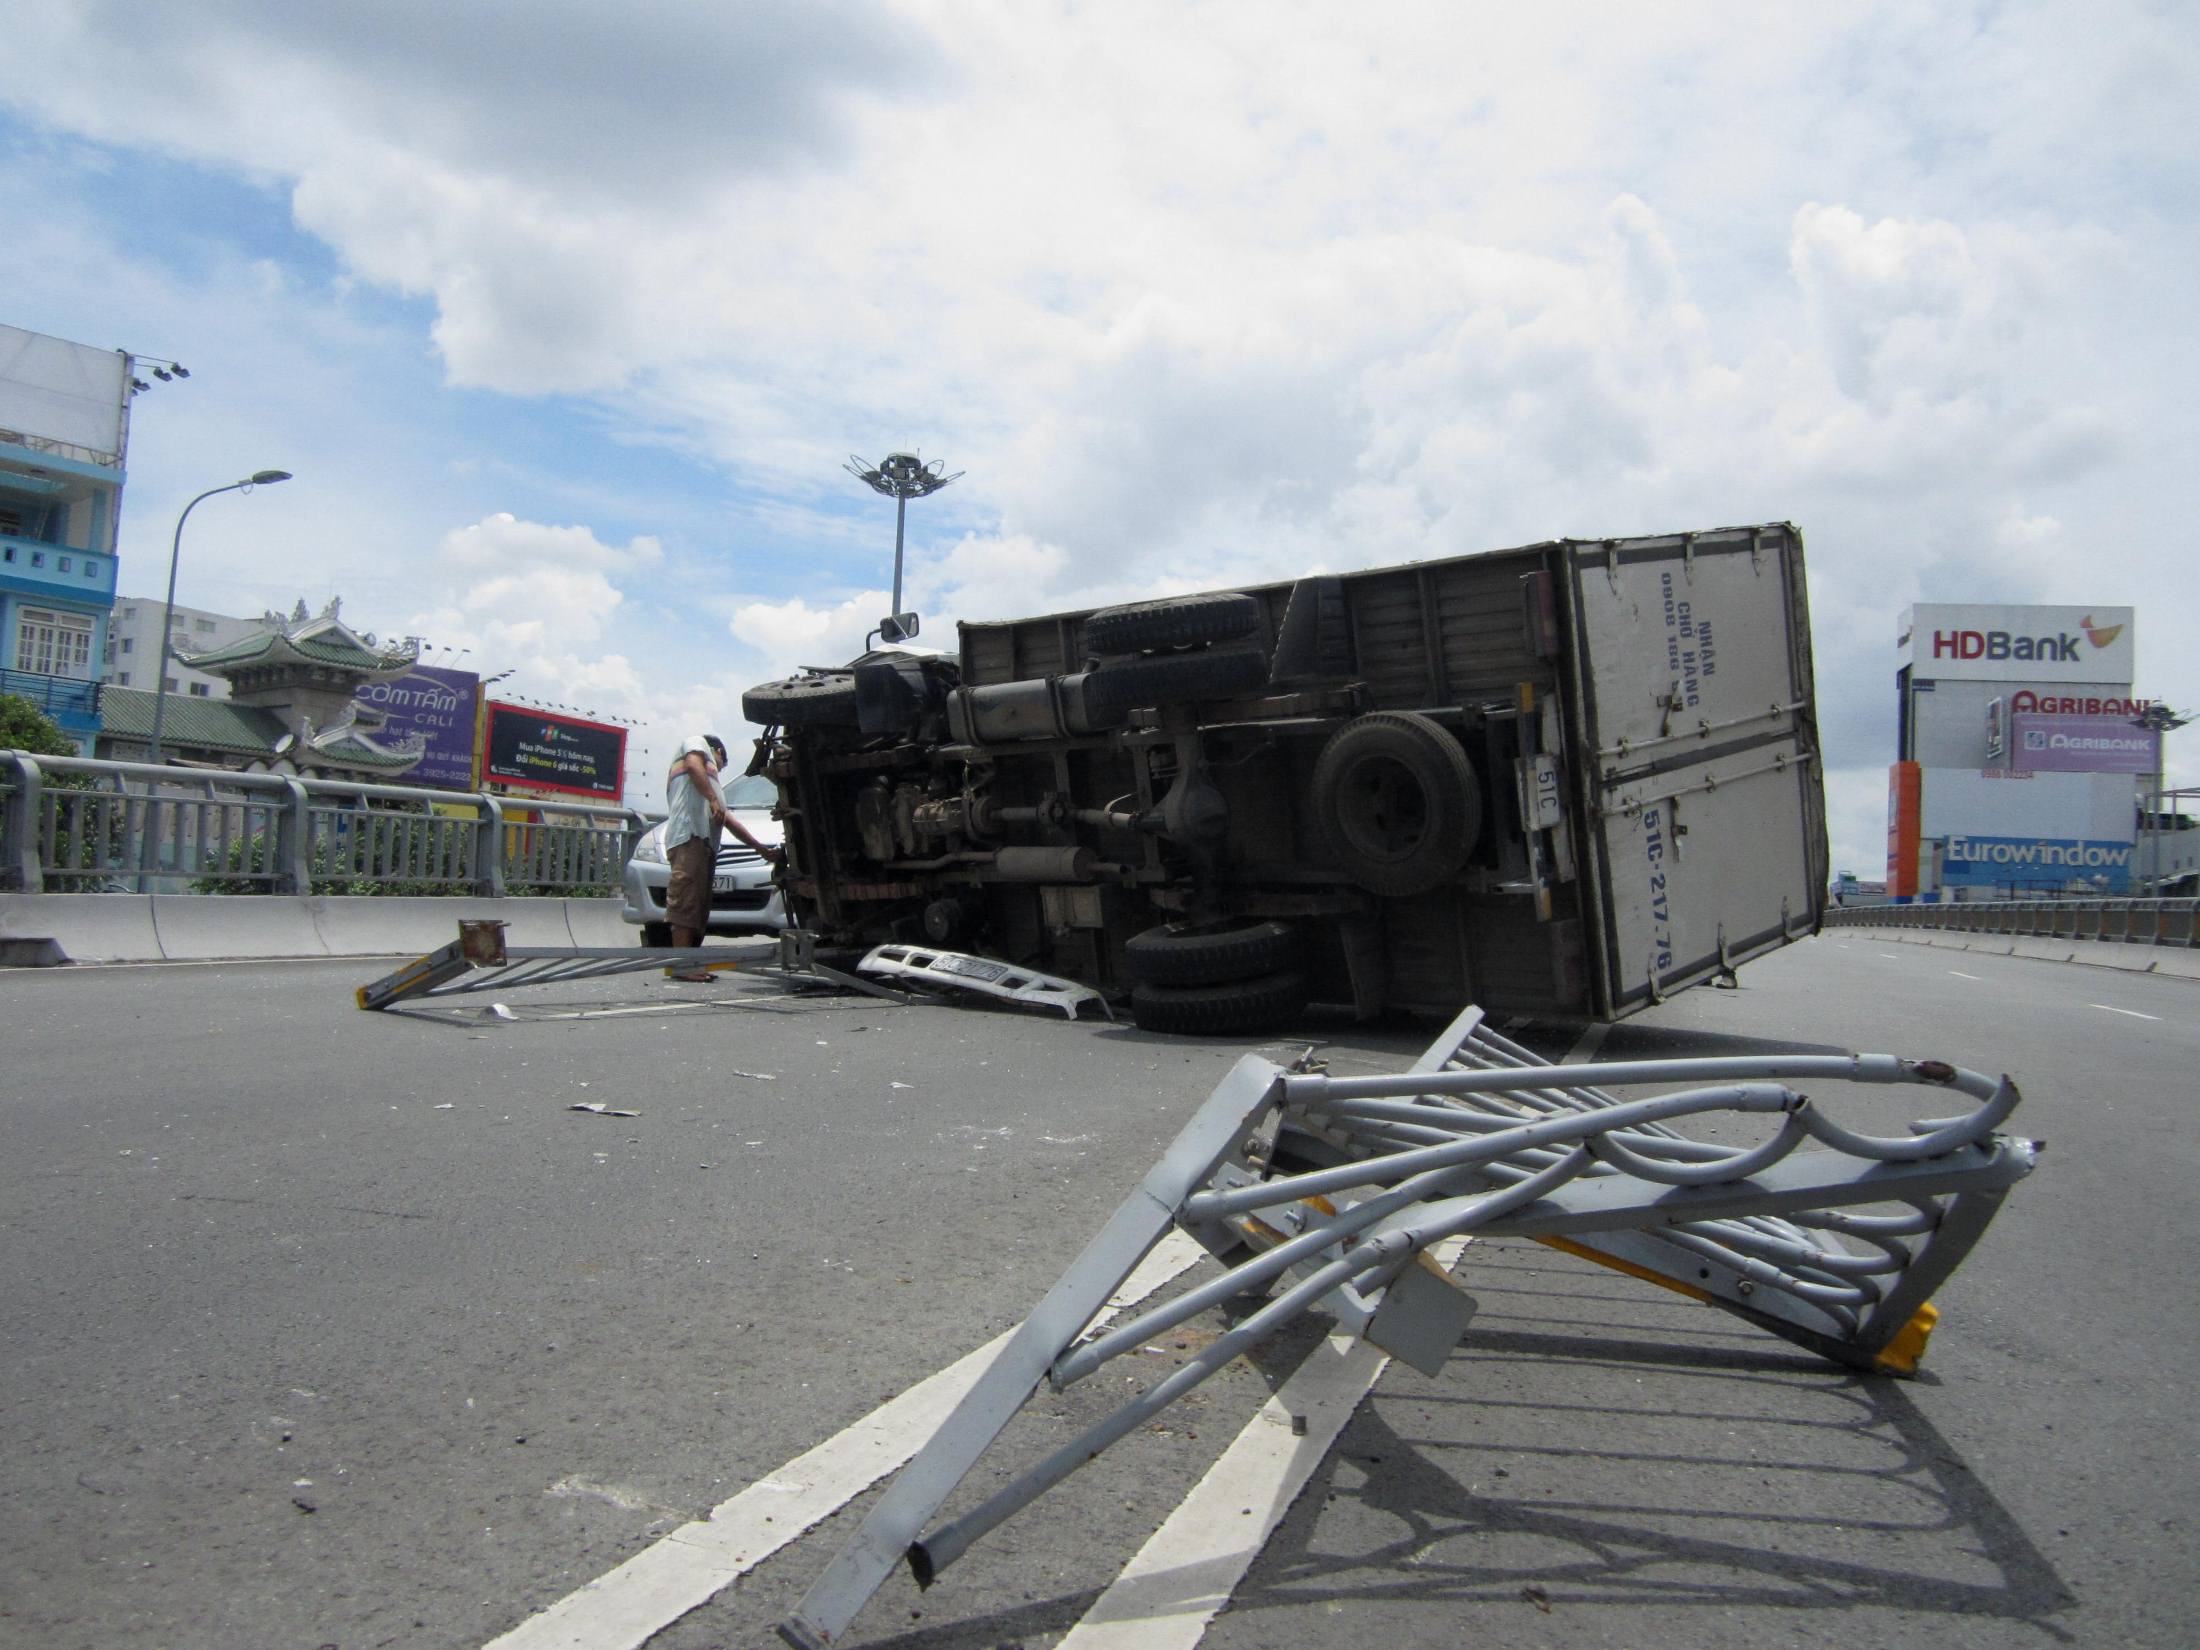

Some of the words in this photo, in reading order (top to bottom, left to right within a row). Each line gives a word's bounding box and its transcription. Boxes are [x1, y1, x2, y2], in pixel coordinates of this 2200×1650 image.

[1661, 572, 1675, 626] 0908
[1933, 630, 2081, 662] HDBank
[1682, 651, 1699, 707] HÀNG
[412, 688, 457, 711] TẤM
[415, 713, 453, 727] CALI
[519, 742, 534, 752] Mua
[535, 745, 556, 756] iPhone
[2050, 733, 2150, 751] AGRIBANK
[529, 755, 552, 767] iPhone
[552, 761, 557, 769] 6
[1538, 771, 1557, 808] 51C
[1948, 836, 2130, 867] Eurowindow
[1643, 809, 1672, 970] 51C-217.76
